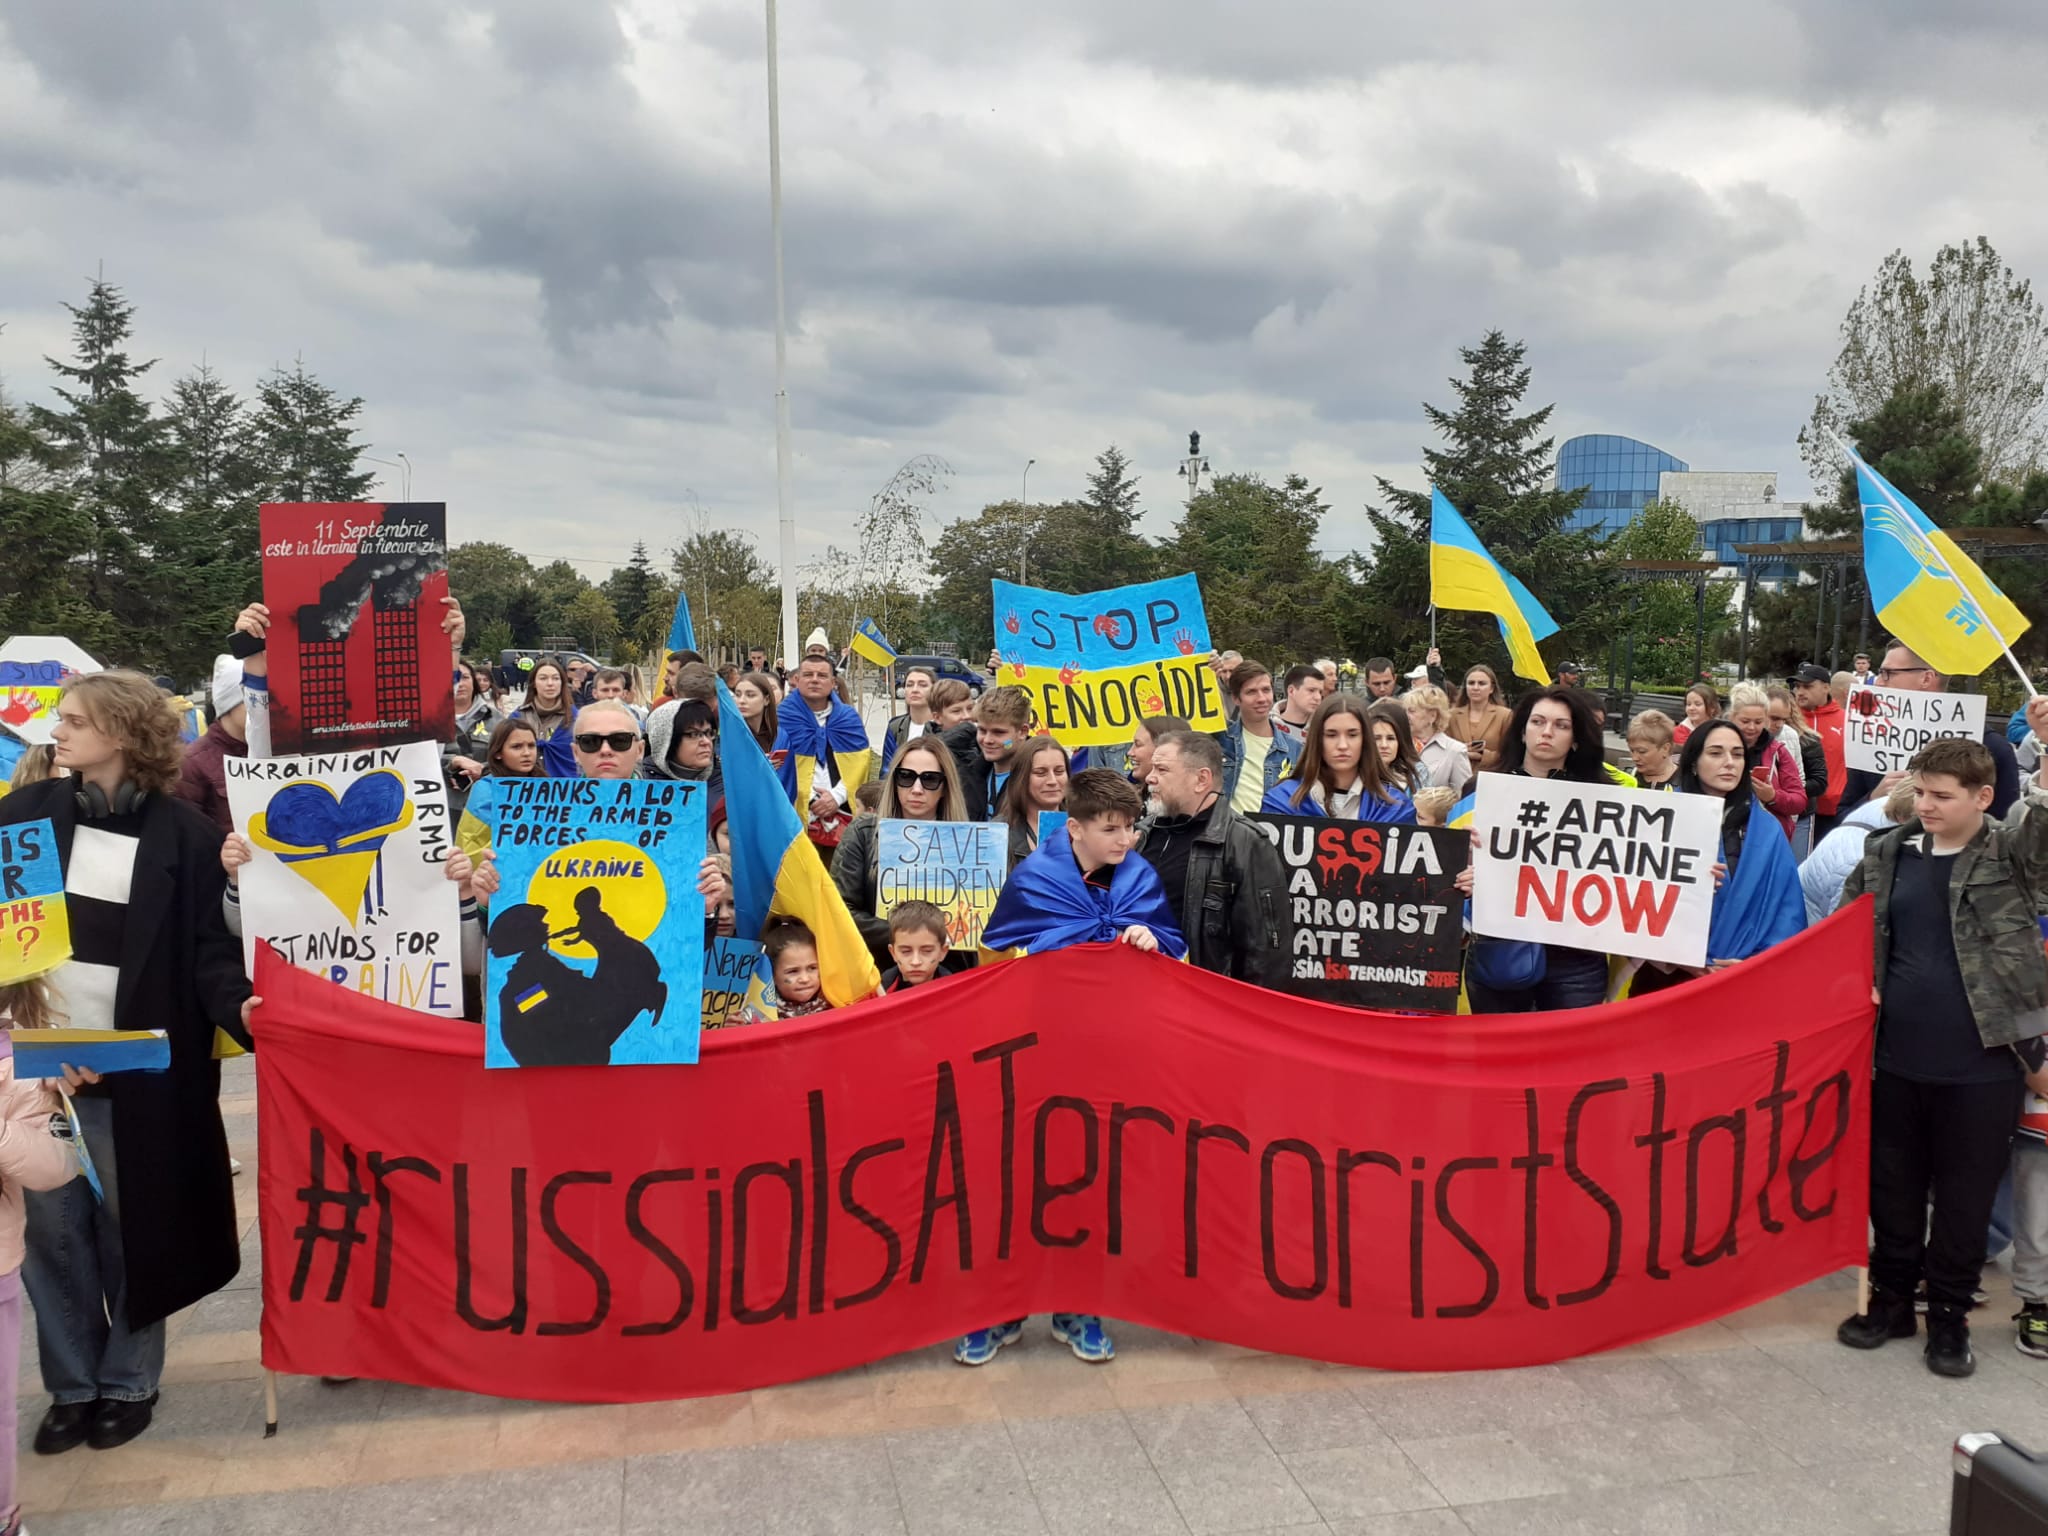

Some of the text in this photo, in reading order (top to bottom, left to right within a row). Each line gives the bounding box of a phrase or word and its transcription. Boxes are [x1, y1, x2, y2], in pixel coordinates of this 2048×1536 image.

[265, 539, 293, 557] este
[312, 537, 358, 556] Ucraina
[375, 538, 417, 556] fiecare
[422, 537, 435, 553] zi
[315, 517, 429, 543] 11 Septembrie
[1031, 600, 1180, 652] STOP
[1848, 690, 1965, 722] RUSSIA IS A
[498, 779, 697, 806] THANKS A LOT
[498, 804, 673, 827] TO THE ARMED
[1517, 798, 1676, 843] #ARM
[496, 823, 668, 848] FORCES OF
[898, 825, 990, 866] SAVE
[1490, 826, 1700, 884] UKRAINE
[1288, 868, 1318, 897] A
[1515, 865, 1681, 938] NOW
[267, 926, 440, 966] STANDS FOR
[703, 938, 760, 981] Never
